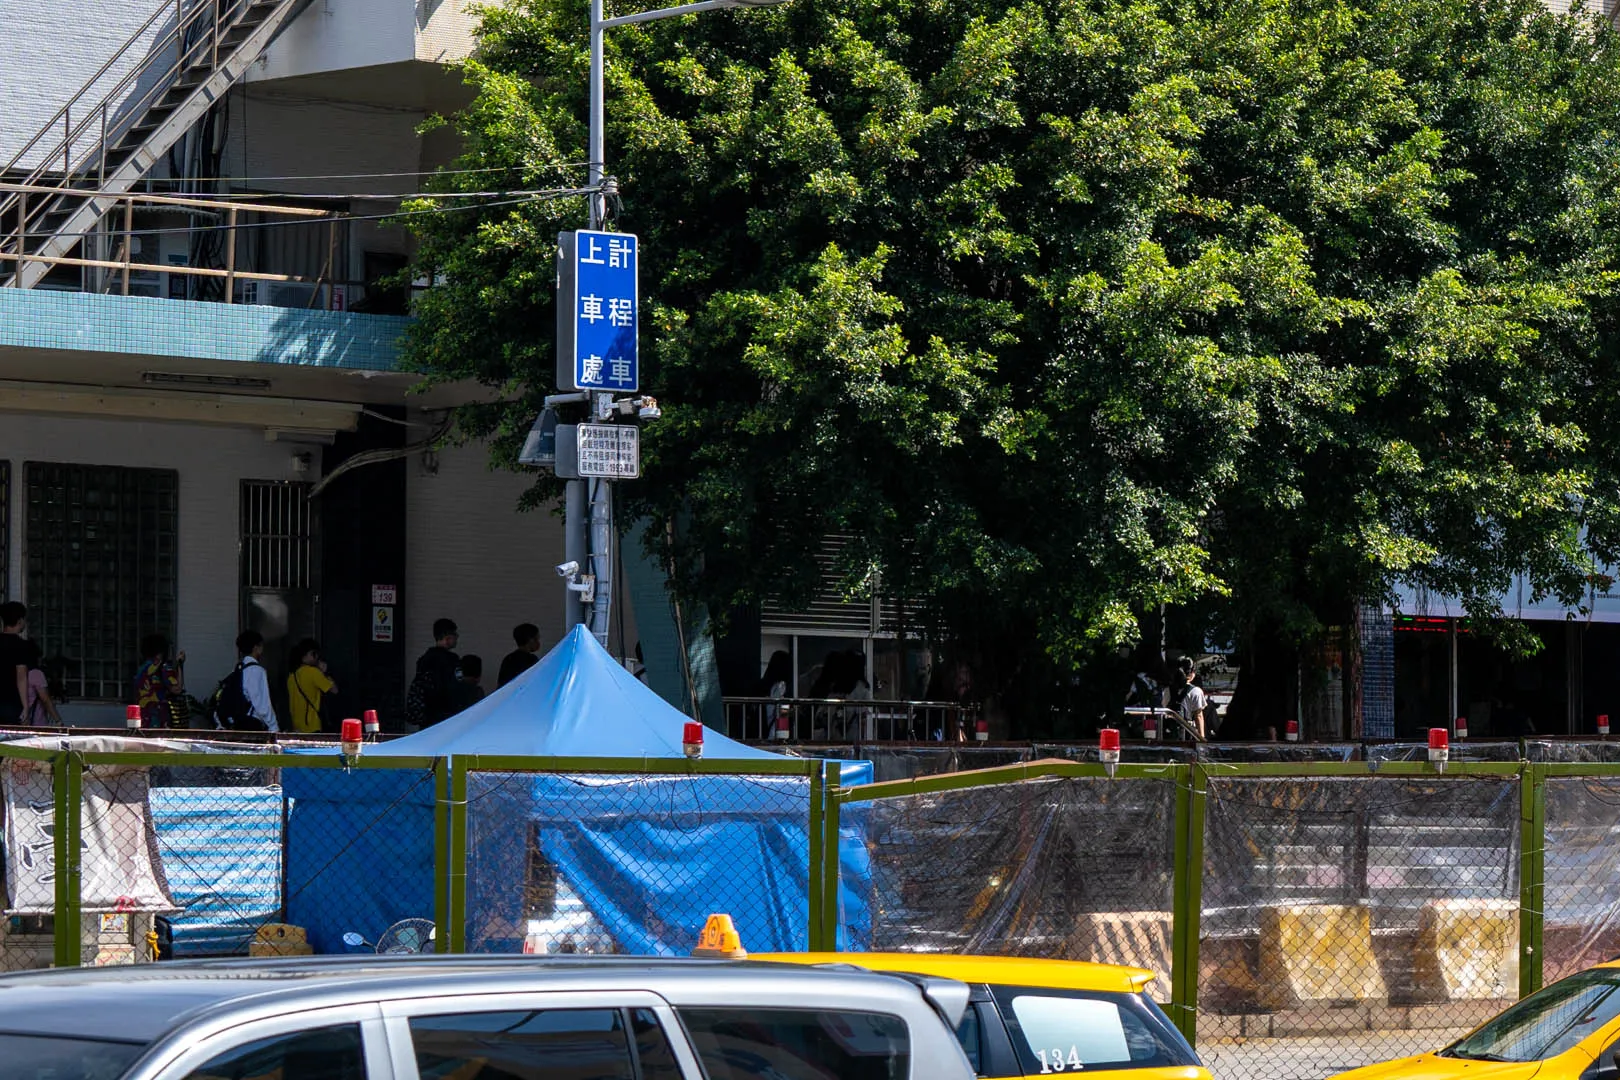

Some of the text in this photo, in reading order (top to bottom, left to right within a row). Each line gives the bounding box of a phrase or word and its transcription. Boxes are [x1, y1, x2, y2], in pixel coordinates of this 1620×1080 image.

[580, 236, 605, 386] 上車處
[608, 238, 633, 387] 計程車
[1037, 1044, 1084, 1074] 134
